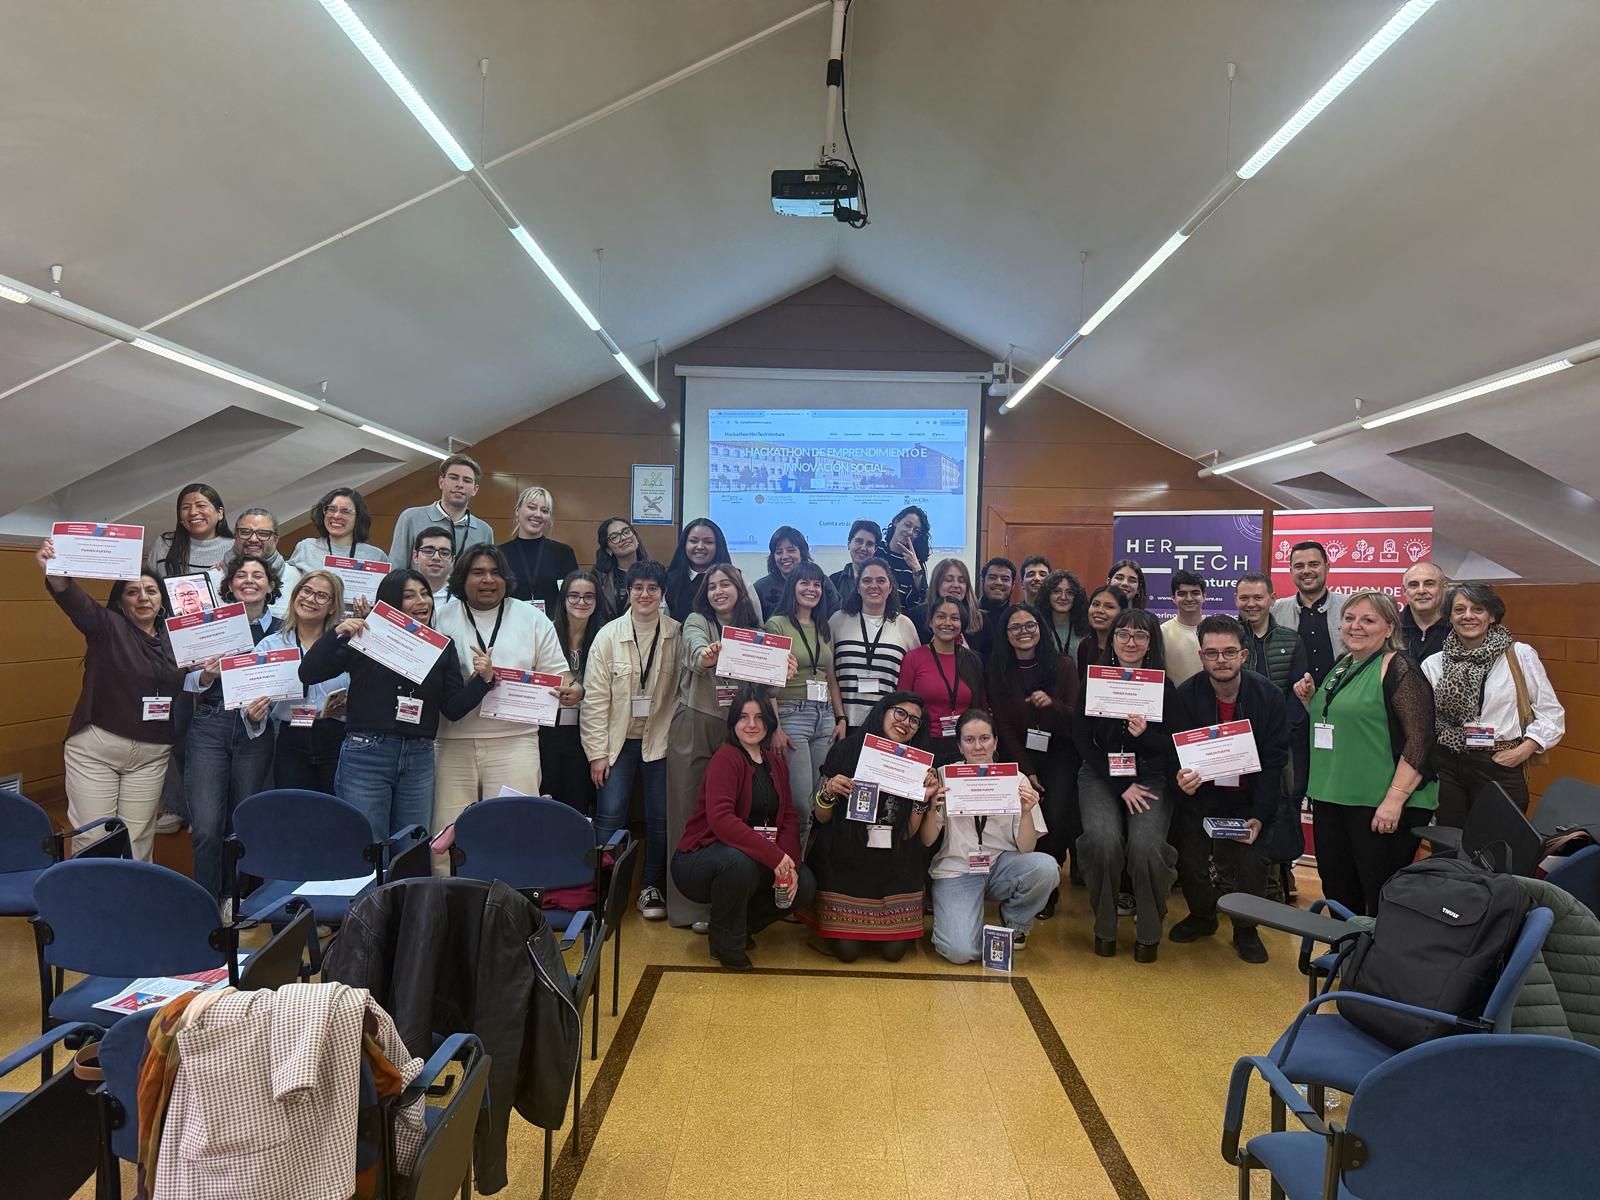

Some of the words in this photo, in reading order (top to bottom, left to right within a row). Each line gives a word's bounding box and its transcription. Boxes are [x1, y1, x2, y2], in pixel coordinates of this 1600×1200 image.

[745, 447, 810, 457] HACKATHON
[811, 447, 826, 457] DE
[828, 447, 920, 458] EMPRENDIMIENTO
[920, 448, 928, 458] E
[851, 463, 886, 473] SOCIAL
[1126, 539, 1172, 553] HER
[1174, 554, 1248, 571] TECH
[1383, 586, 1402, 597] DE
[1442, 907, 1460, 919] THULE
